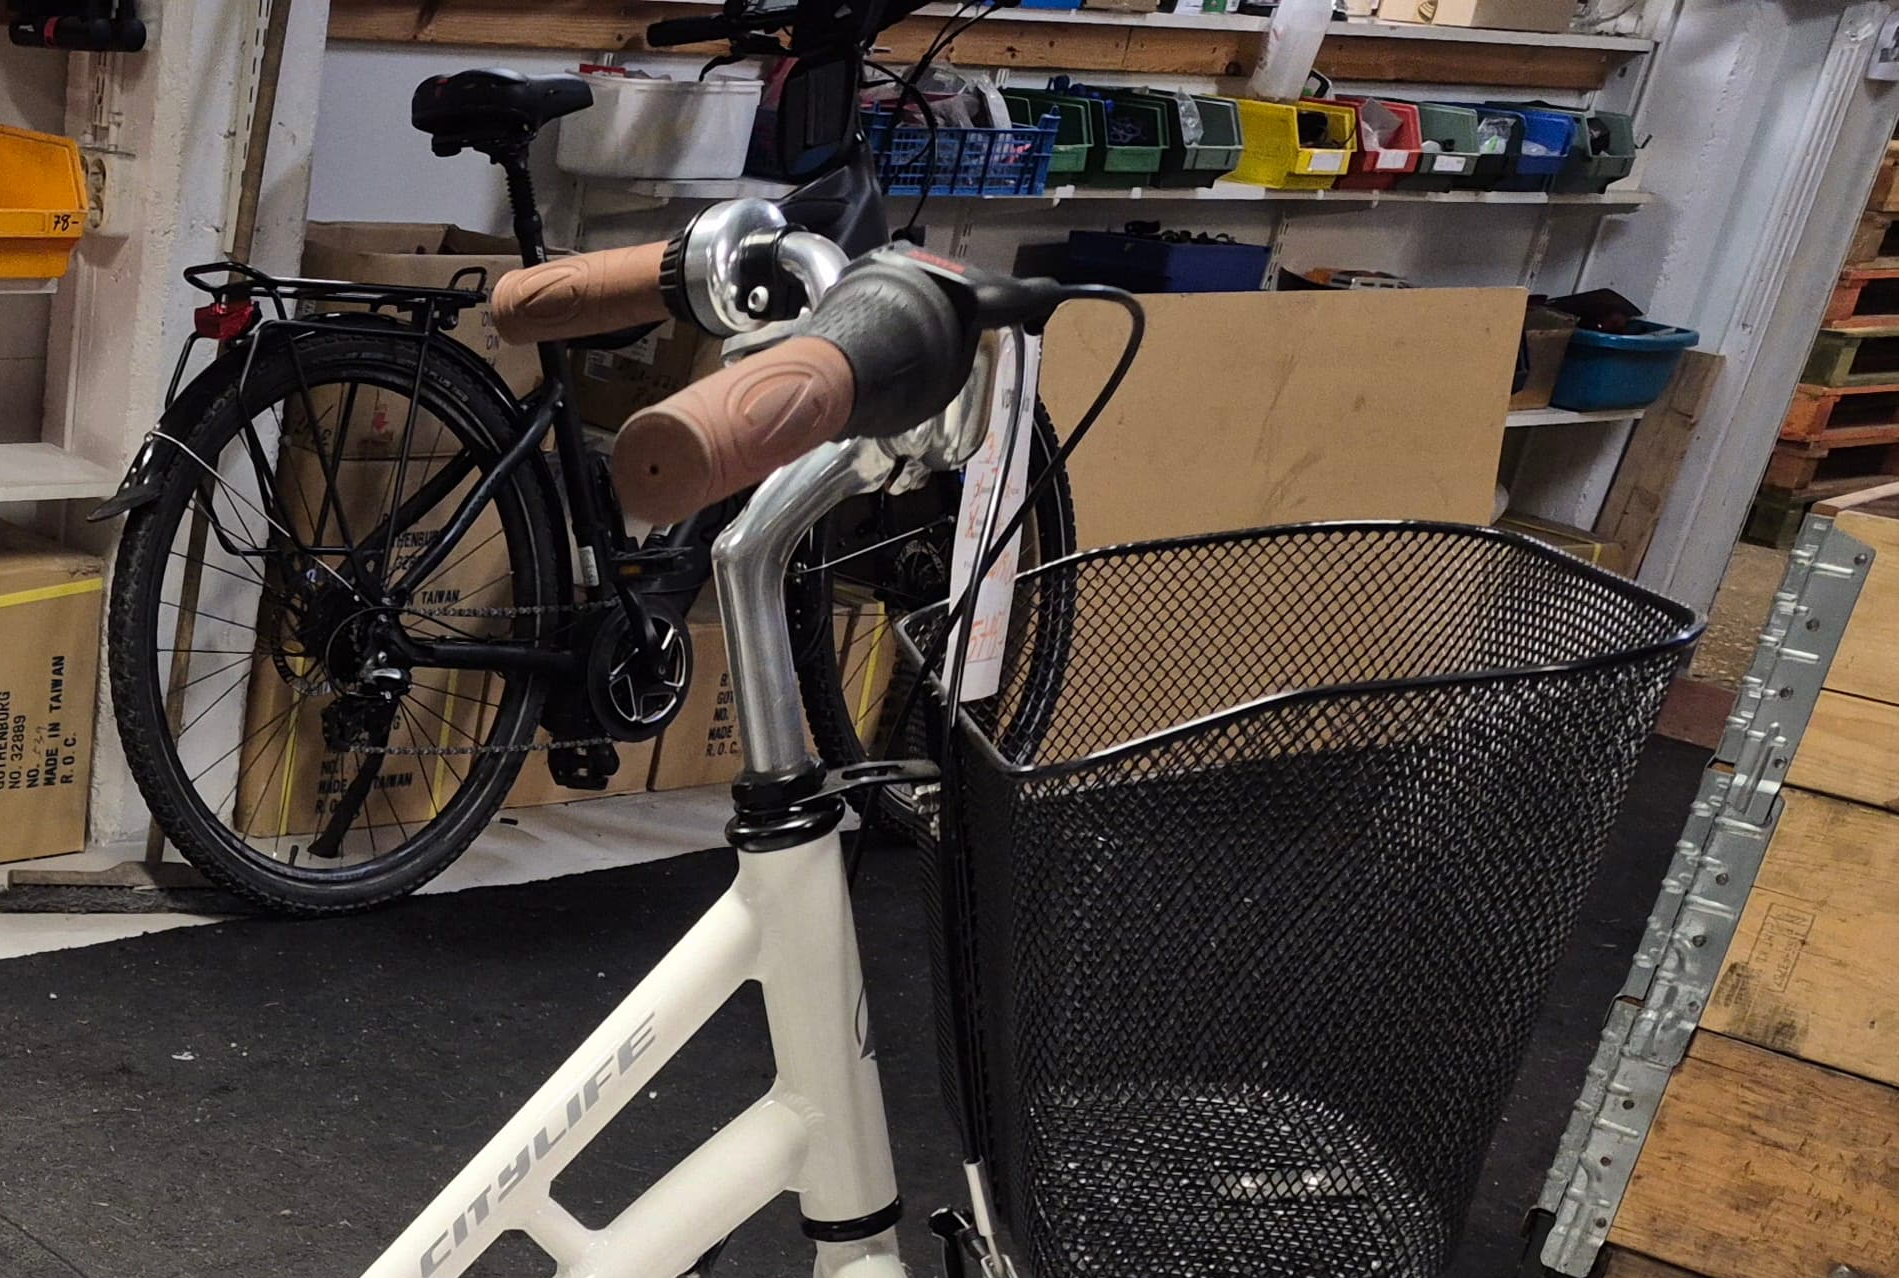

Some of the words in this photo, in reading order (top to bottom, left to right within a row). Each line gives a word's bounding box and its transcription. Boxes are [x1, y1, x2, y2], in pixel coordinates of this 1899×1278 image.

[421, 589, 460, 604] TAIWAN
[49, 655, 65, 714] TAIWAN
[11, 715, 26, 762] 32889
[48, 722, 61, 738] IN
[708, 725, 734, 740] MADE
[26, 763, 40, 788] NO.
[43, 747, 59, 786] MADE
[317, 779, 348, 794] MADE
